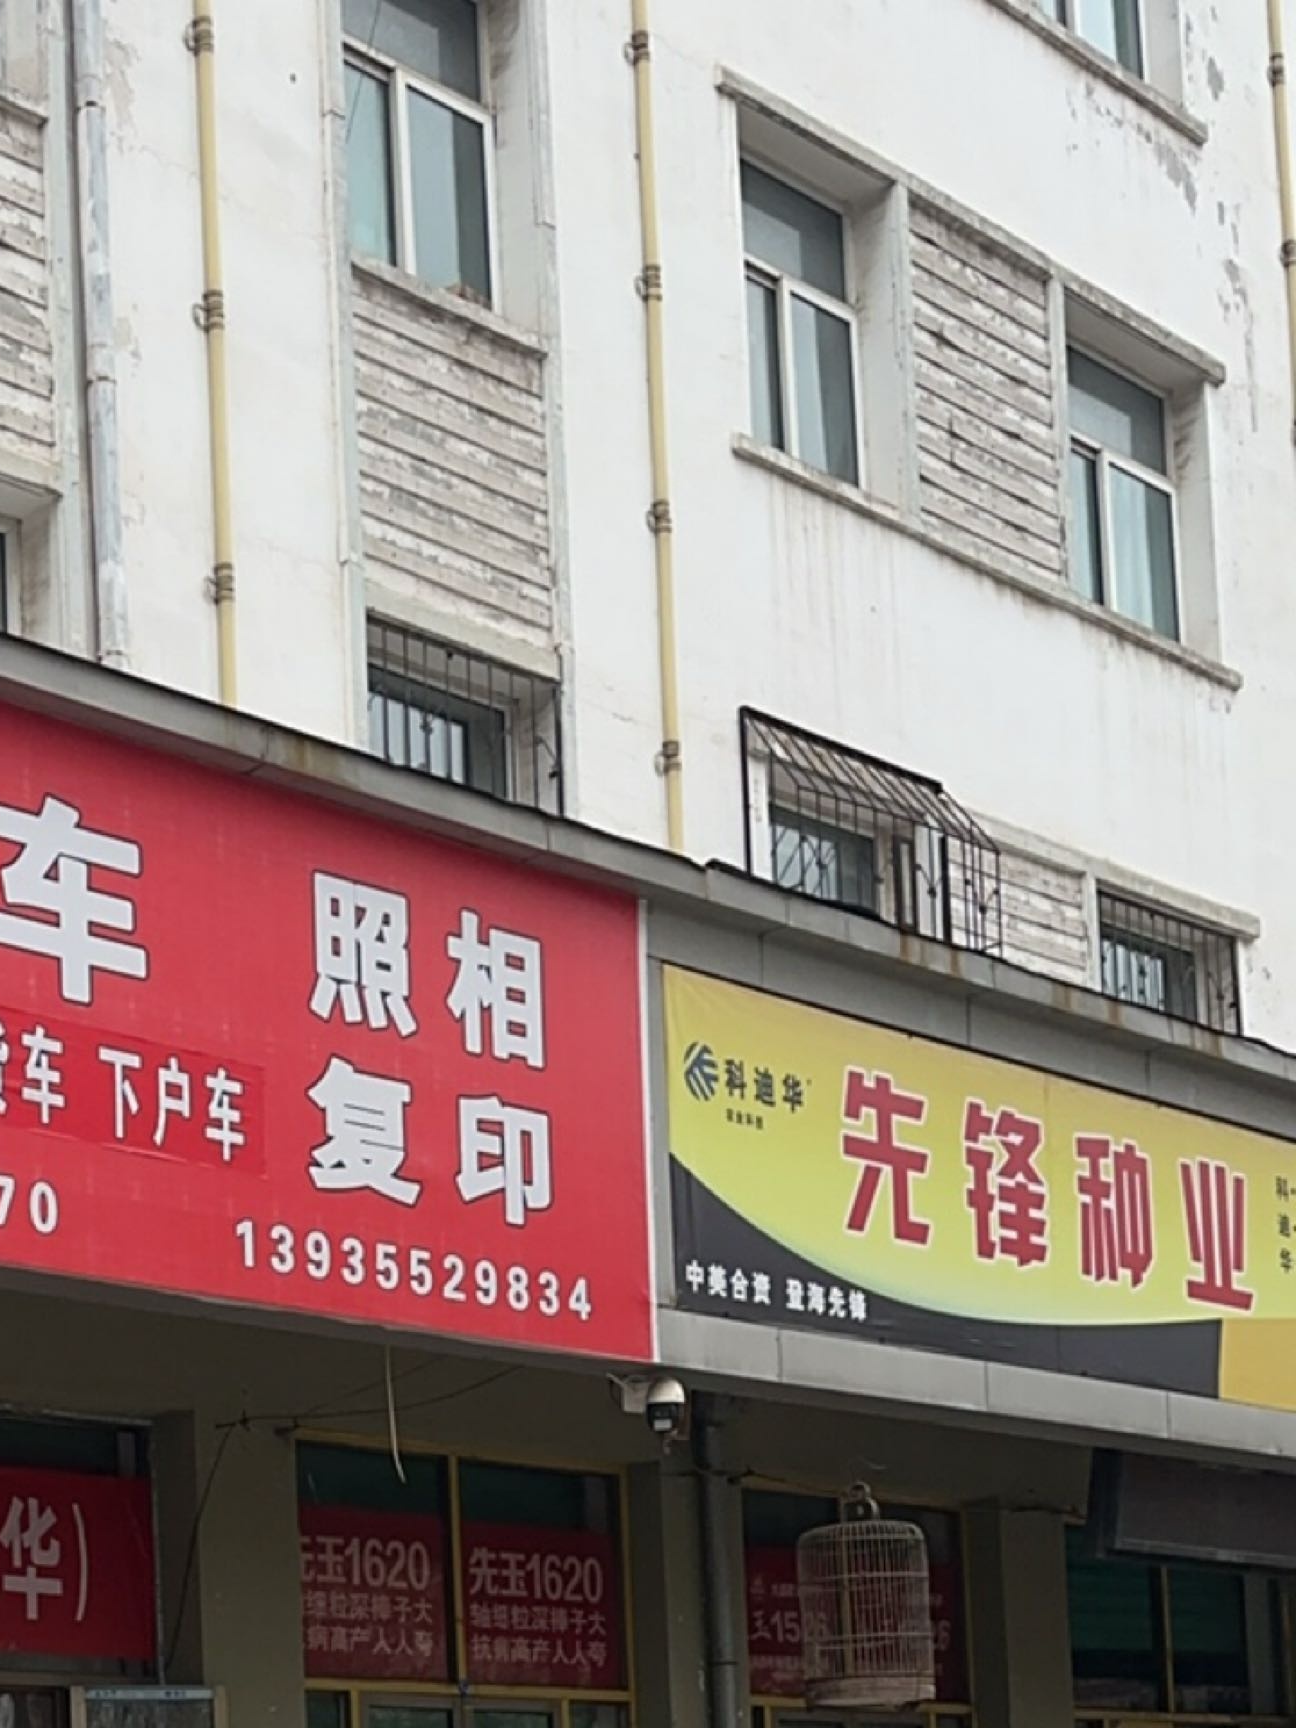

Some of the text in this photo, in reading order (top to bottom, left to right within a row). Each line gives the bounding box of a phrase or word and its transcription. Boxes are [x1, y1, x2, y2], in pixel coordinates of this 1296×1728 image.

[308, 869, 546, 1069] 照相
[98, 1044, 246, 1162] 下户车
[307, 1054, 552, 1226] 复印
[839, 1063, 1255, 1312] 先锋种业
[235, 1218, 593, 1321] 13935529834
[468, 1546, 604, 1604] 先玉1620
